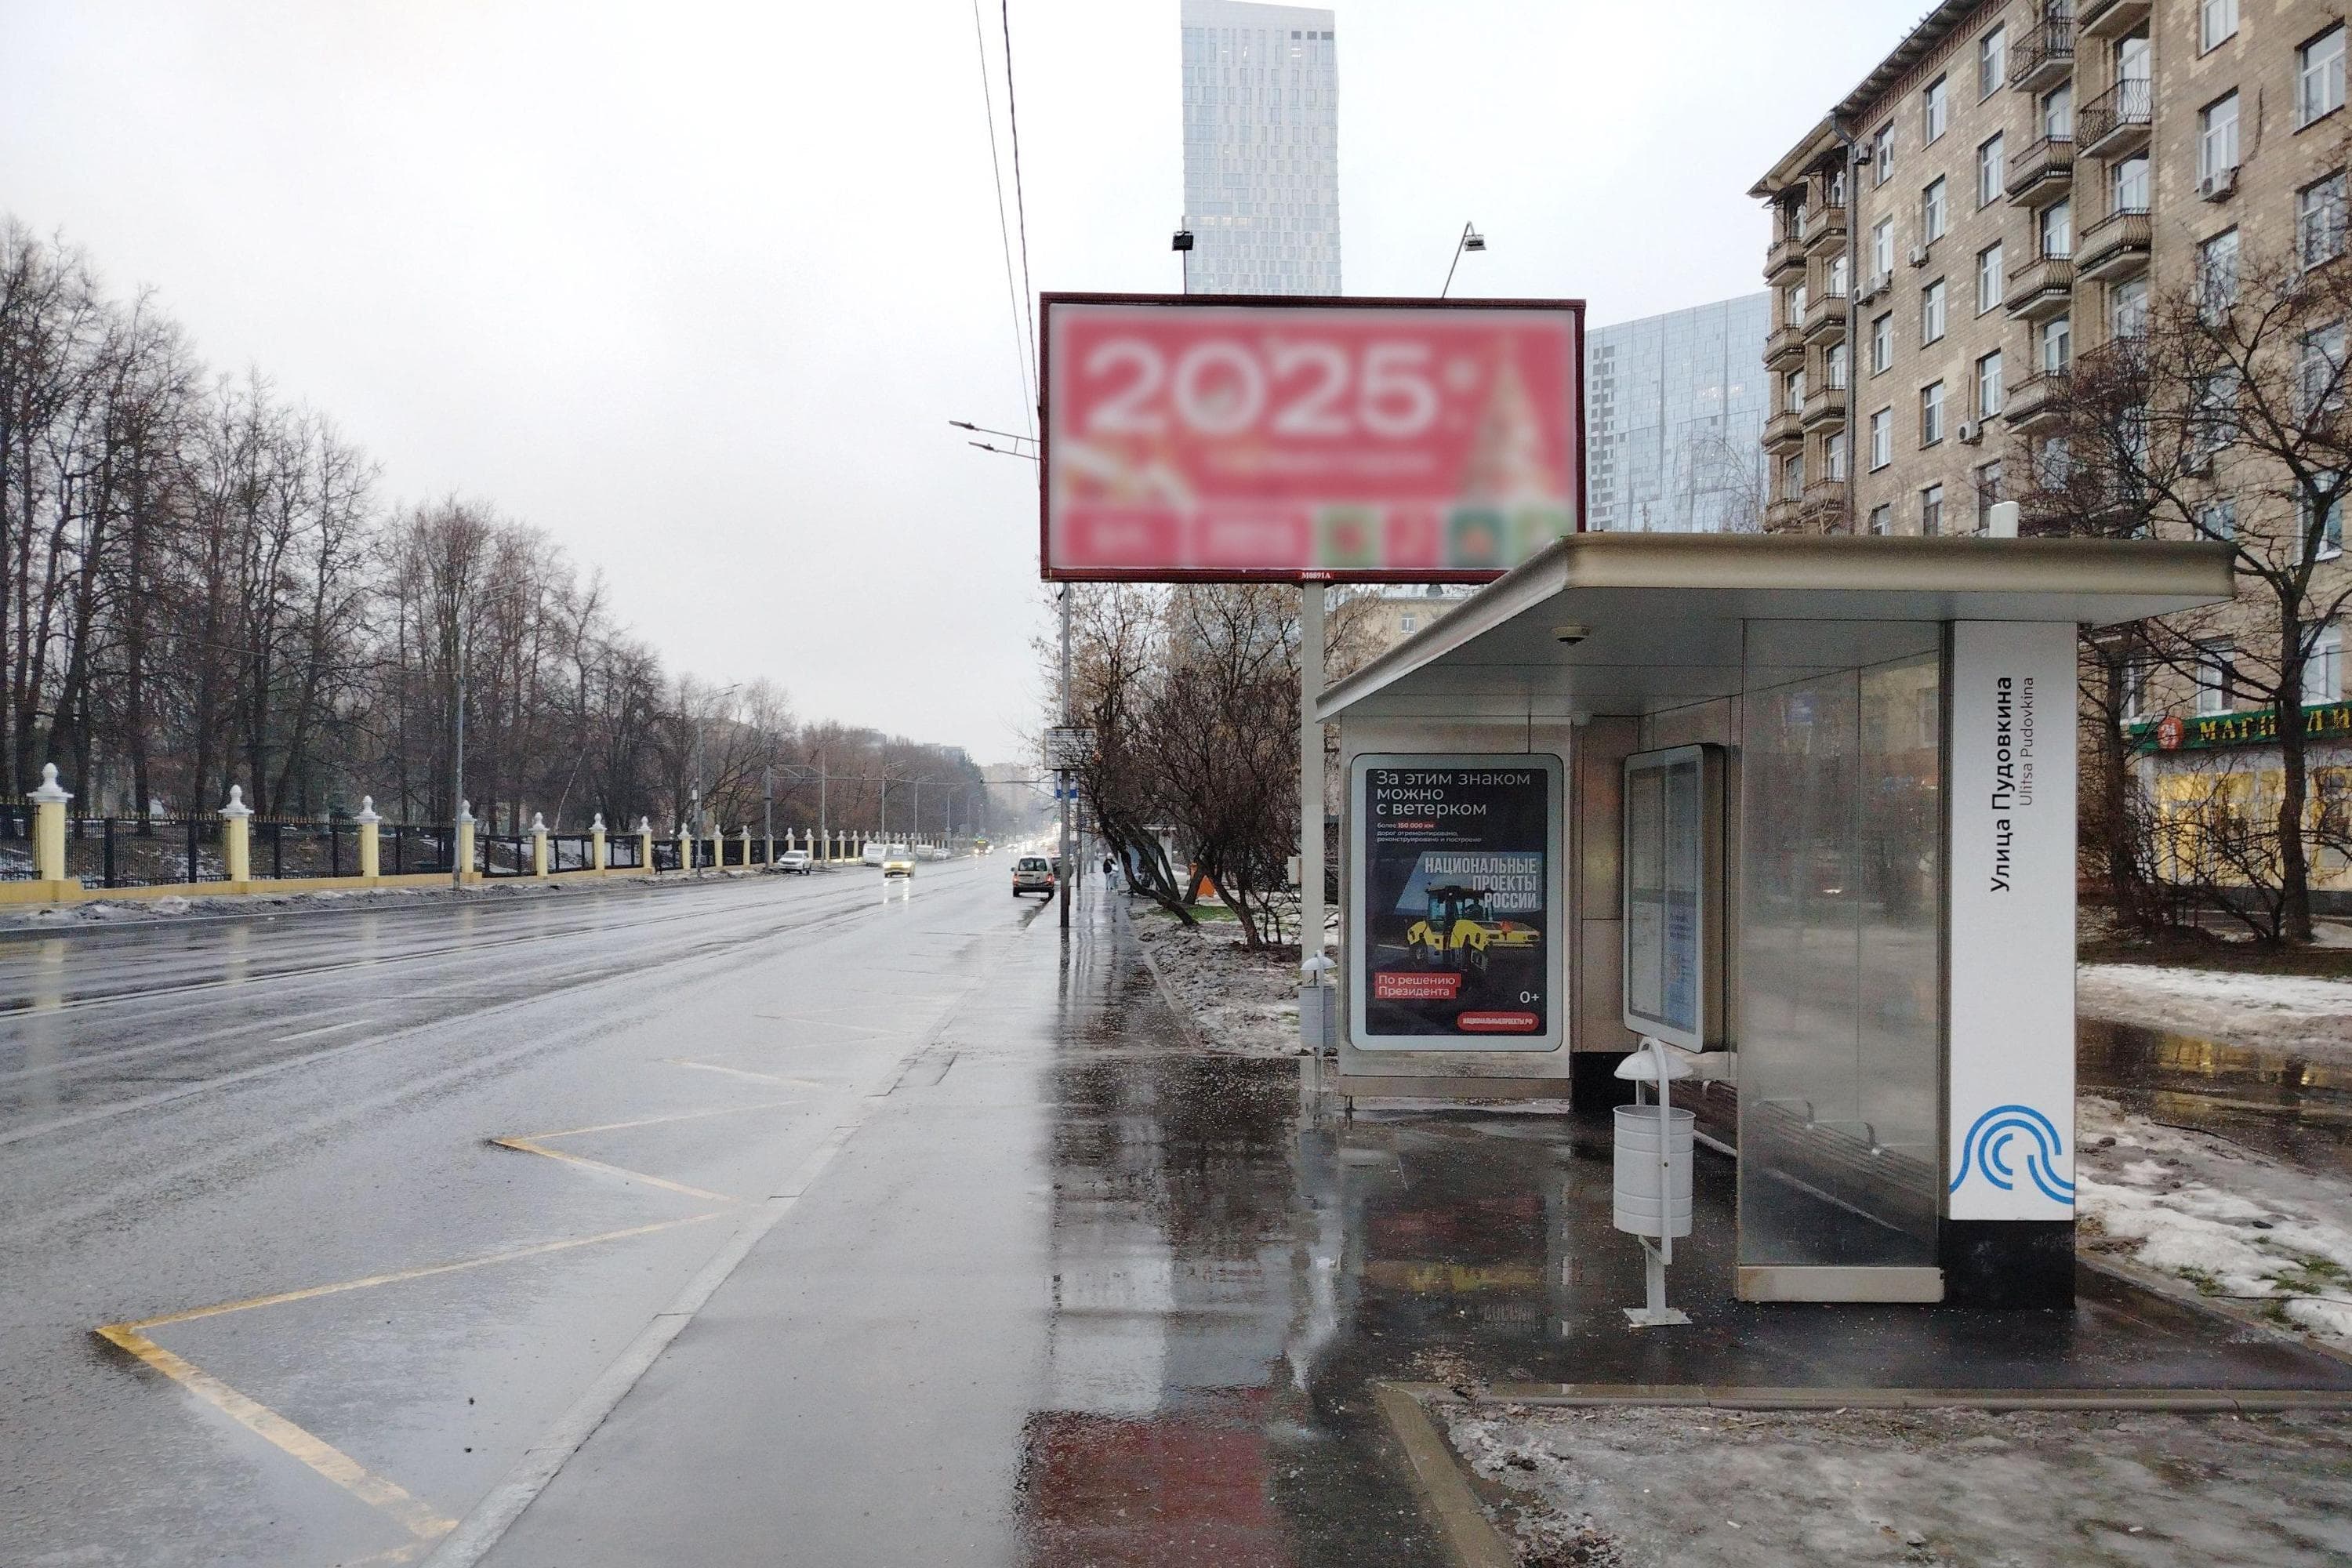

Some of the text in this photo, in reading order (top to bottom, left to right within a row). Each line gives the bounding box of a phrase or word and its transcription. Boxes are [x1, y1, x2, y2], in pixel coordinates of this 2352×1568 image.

[1087, 339, 1439, 437] 2025
[2200, 708, 2350, 742] МАГНЛИ
[2019, 677, 2034, 806] Ulitsa Pudovkina
[1377, 770, 1530, 786] За этим знаком
[1990, 677, 2015, 892] Улица Пудовкина
[1377, 788, 1444, 800] можно
[1376, 804, 1486, 818] с ветерком
[1425, 857, 1537, 875] НАЦИОНАЛЬНЫЕ
[1472, 875, 1537, 891] ПРОЕКТЫ
[1484, 892, 1537, 909] РОССИИ
[1378, 975, 1456, 986] По решению
[1378, 986, 1450, 997] Президента
[1519, 991, 1540, 1004] 0+
